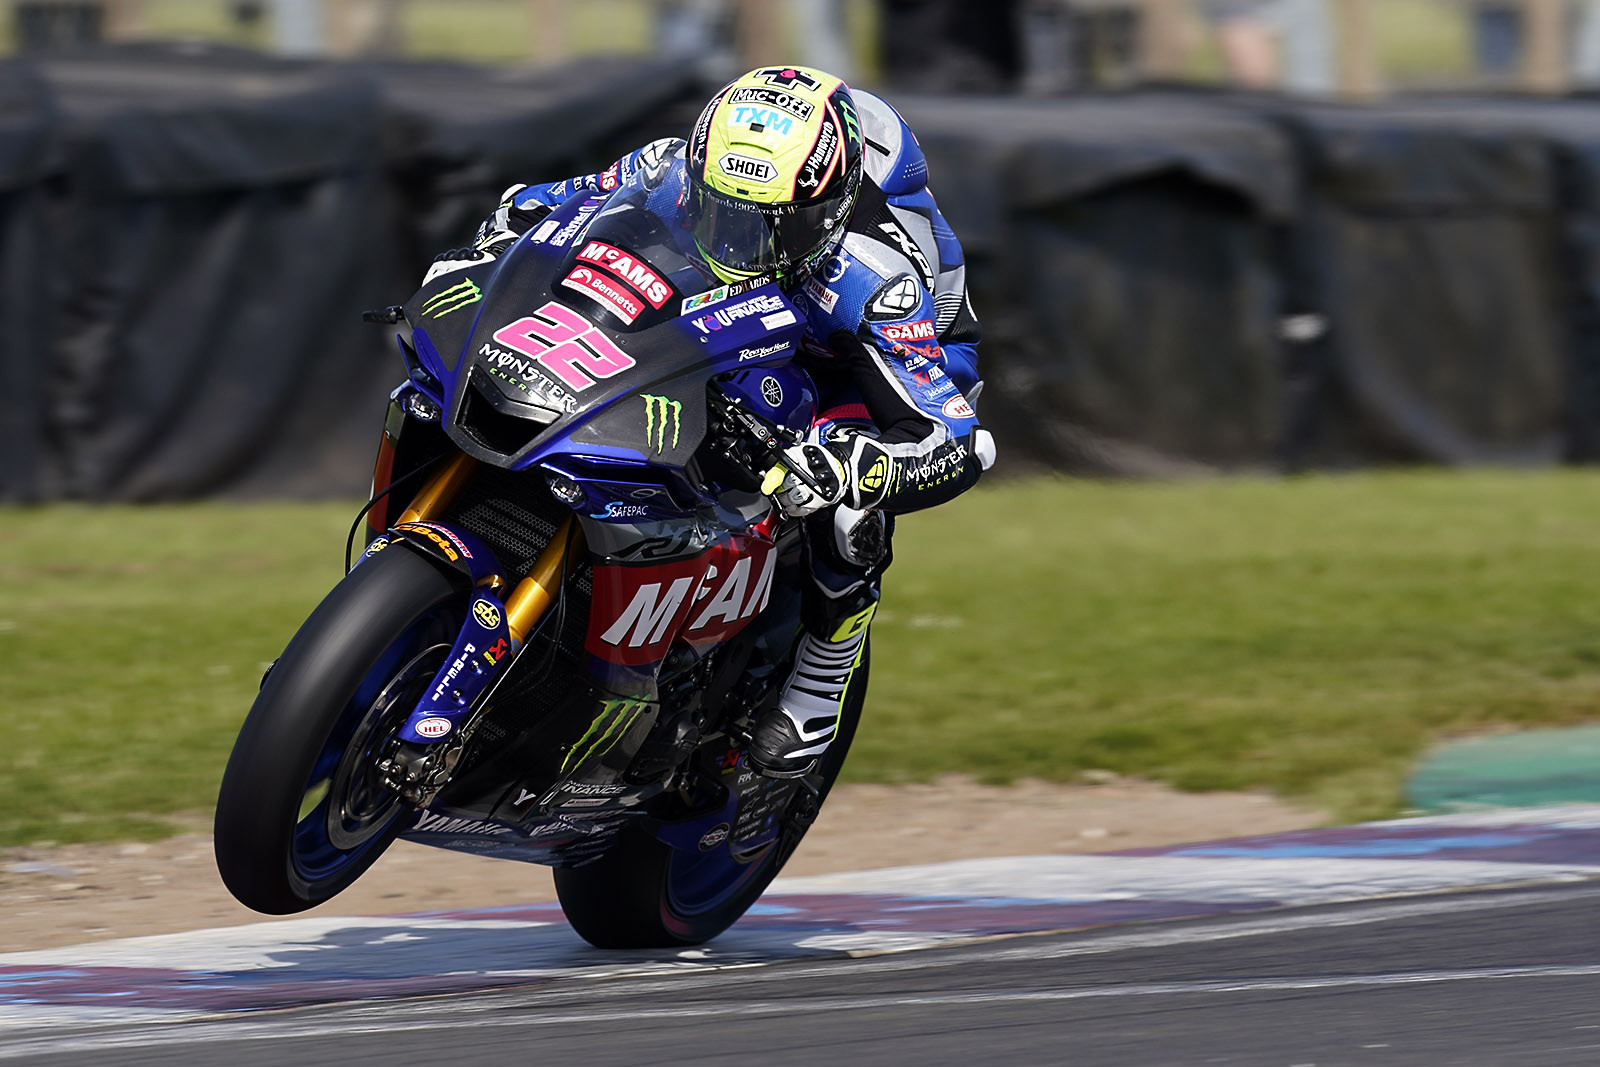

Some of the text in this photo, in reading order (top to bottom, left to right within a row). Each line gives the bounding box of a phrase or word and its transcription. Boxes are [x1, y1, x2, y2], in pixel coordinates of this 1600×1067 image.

[735, 107, 793, 135] TXM
[807, 121, 834, 170] Hanworth
[726, 158, 770, 178] SHOEI
[579, 243, 668, 304] McAMS
[729, 274, 770, 297] EDWARDS
[591, 278, 637, 315] Bennetts
[727, 295, 785, 321] FINANCE
[493, 301, 637, 393] 22
[905, 444, 968, 484] MONSTER
[918, 466, 965, 490] ENERGY
[611, 504, 649, 518] SAFEPAC
[431, 642, 476, 702] PIRELLI
[424, 725, 446, 733] HEL
